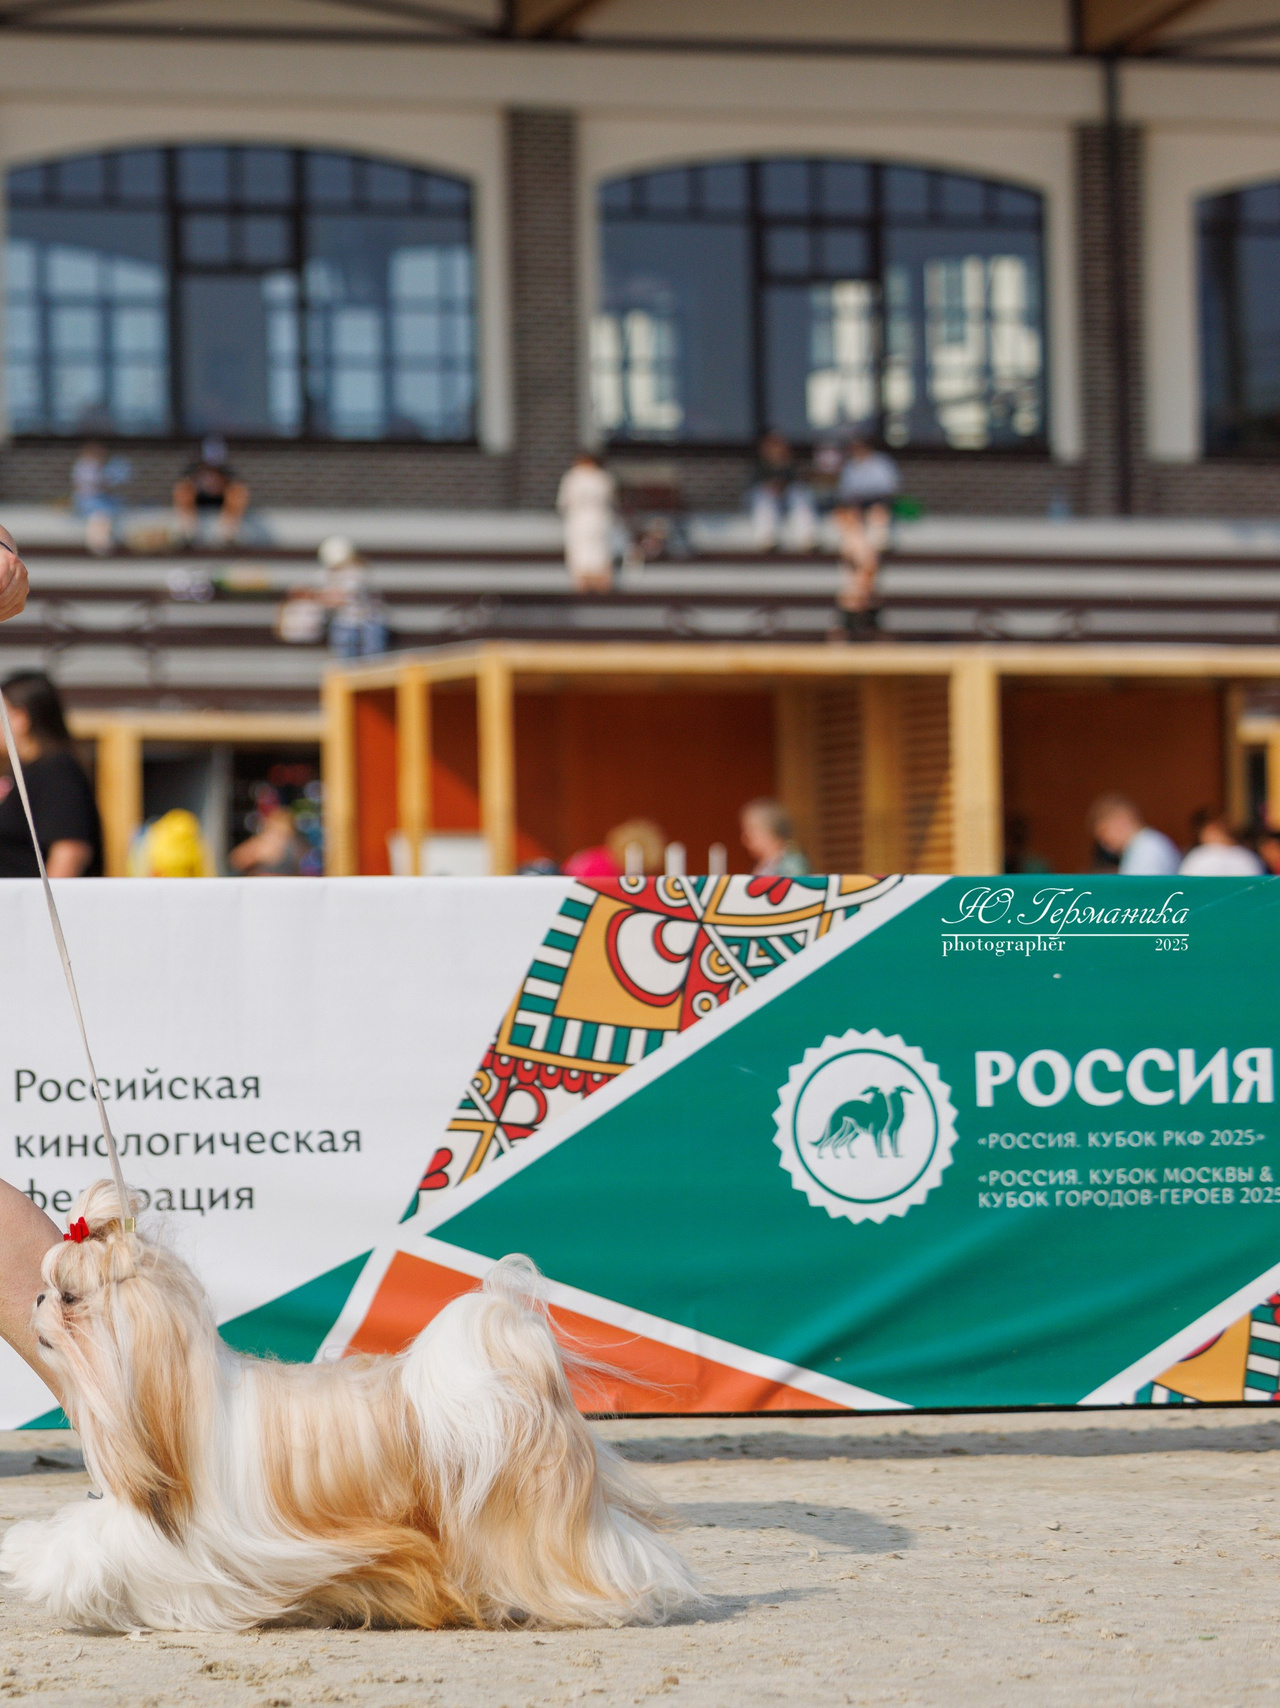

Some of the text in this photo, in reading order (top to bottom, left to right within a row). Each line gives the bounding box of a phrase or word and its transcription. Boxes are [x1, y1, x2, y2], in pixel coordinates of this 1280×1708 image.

[14, 1067, 261, 1102] Российская
[975, 1047, 1274, 1107] РОССИЯ
[15, 1129, 363, 1158] кинологическая
[977, 1129, 1266, 1149] «РОССИЯ. КУБОК РКФ 2025»
[977, 1165, 1273, 1187] «РОССИЯ. КУБОК МОСКВЫ &
[22, 1179, 255, 1216] ферация
[978, 1191, 1049, 1208] КУБОК
[1055, 1187, 1234, 1208] ГОРОДОВ-ГЕРОЕВ
